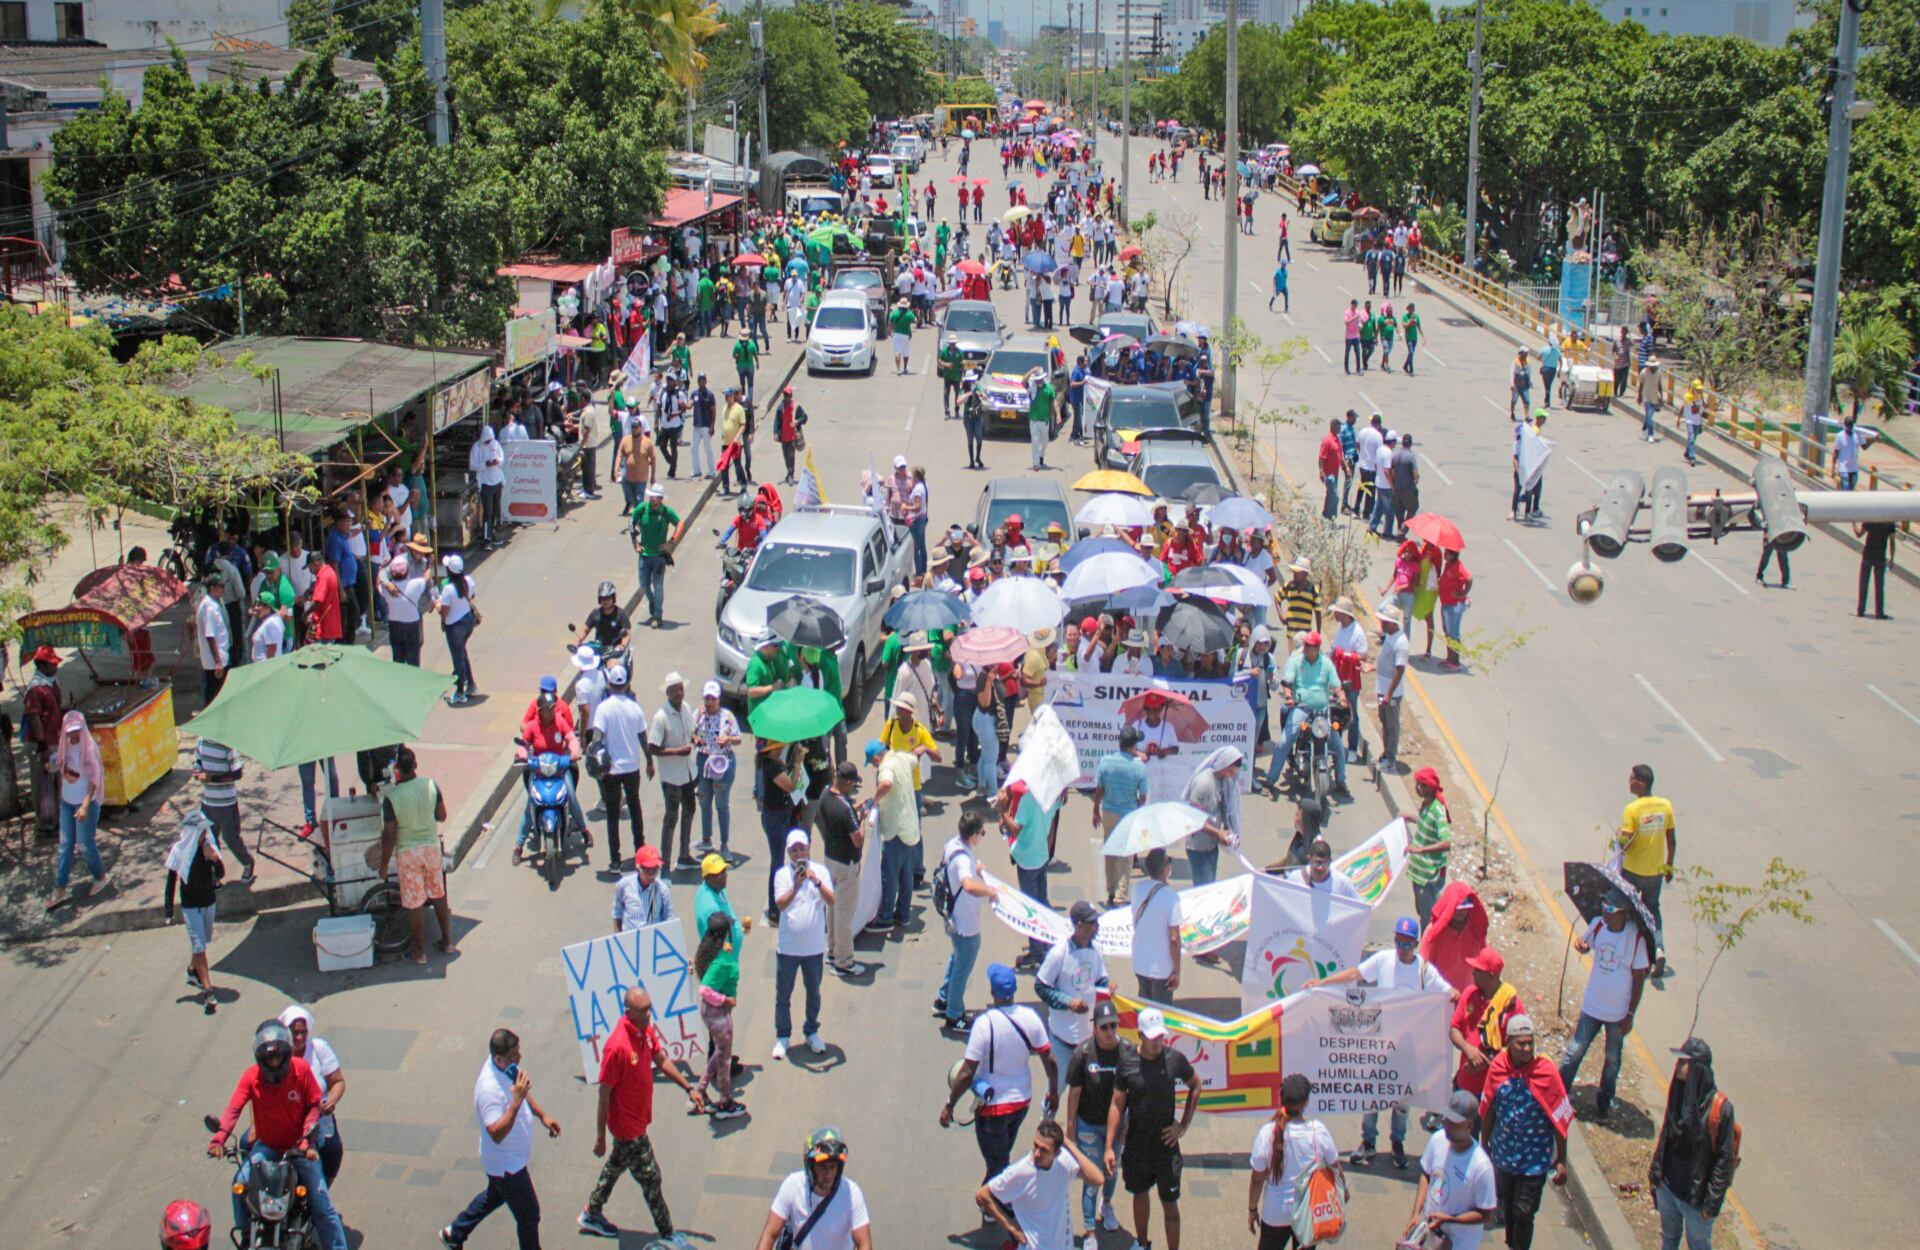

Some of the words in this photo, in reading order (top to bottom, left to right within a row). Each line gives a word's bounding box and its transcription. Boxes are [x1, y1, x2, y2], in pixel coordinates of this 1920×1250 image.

[1066, 720, 1113, 730] REFORMAS
[1210, 734, 1247, 743] COBIJAR
[562, 928, 688, 991] VIVA
[570, 990, 610, 1040] LA
[1319, 1036, 1396, 1051] DESPIERTA
[1328, 1052, 1388, 1065] OBRERO
[1318, 1067, 1399, 1081] HUMILLADO
[1309, 1082, 1374, 1095] SMECAR
[1318, 1099, 1336, 1112] DE
[1341, 1099, 1357, 1111] TU
